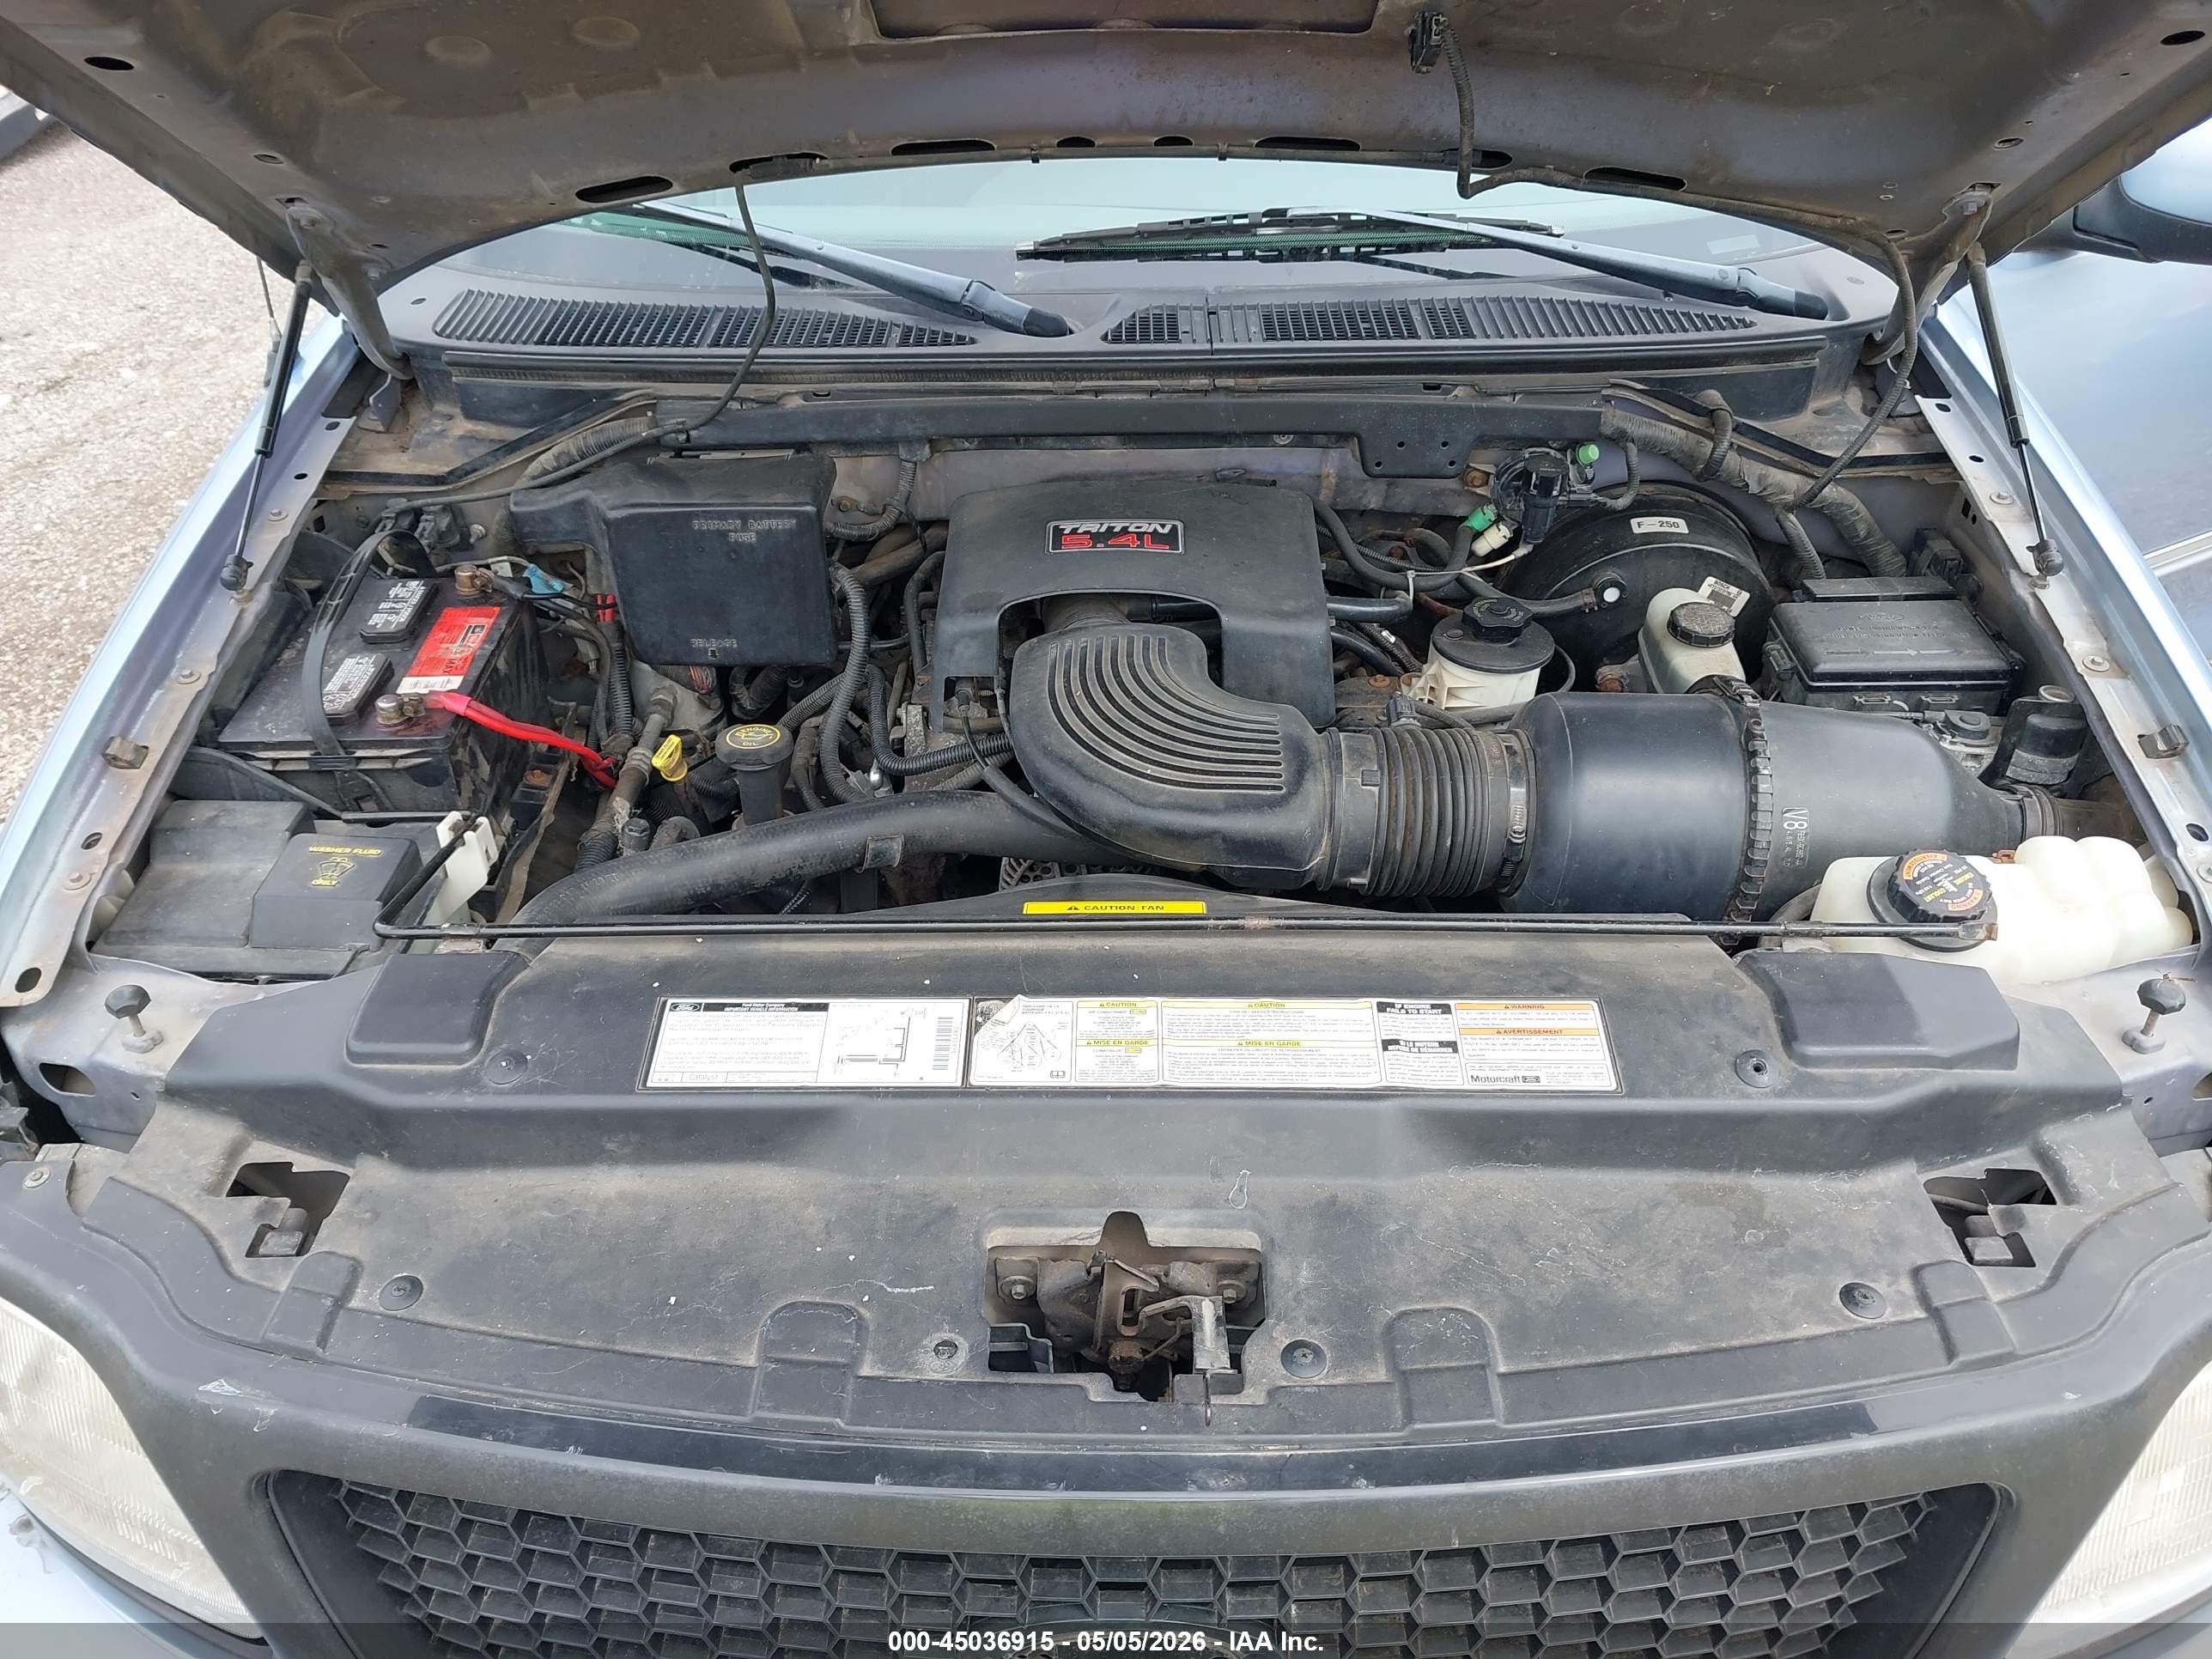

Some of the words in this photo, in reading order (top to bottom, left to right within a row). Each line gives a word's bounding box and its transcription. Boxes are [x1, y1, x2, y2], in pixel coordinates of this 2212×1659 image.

[692, 520, 742, 530] PRIMARY
[748, 520, 797, 530] BATTERY
[1059, 522, 1172, 534] TRITON
[729, 532, 757, 543] FUSE
[1061, 533, 1170, 550] 5.4L
[690, 639, 738, 648] RELEASE
[1784, 810, 1808, 830] V8
[309, 846, 351, 854] WASHER
[352, 848, 382, 856] FLUID
[1470, 1074, 1521, 1084] Motorcraft
